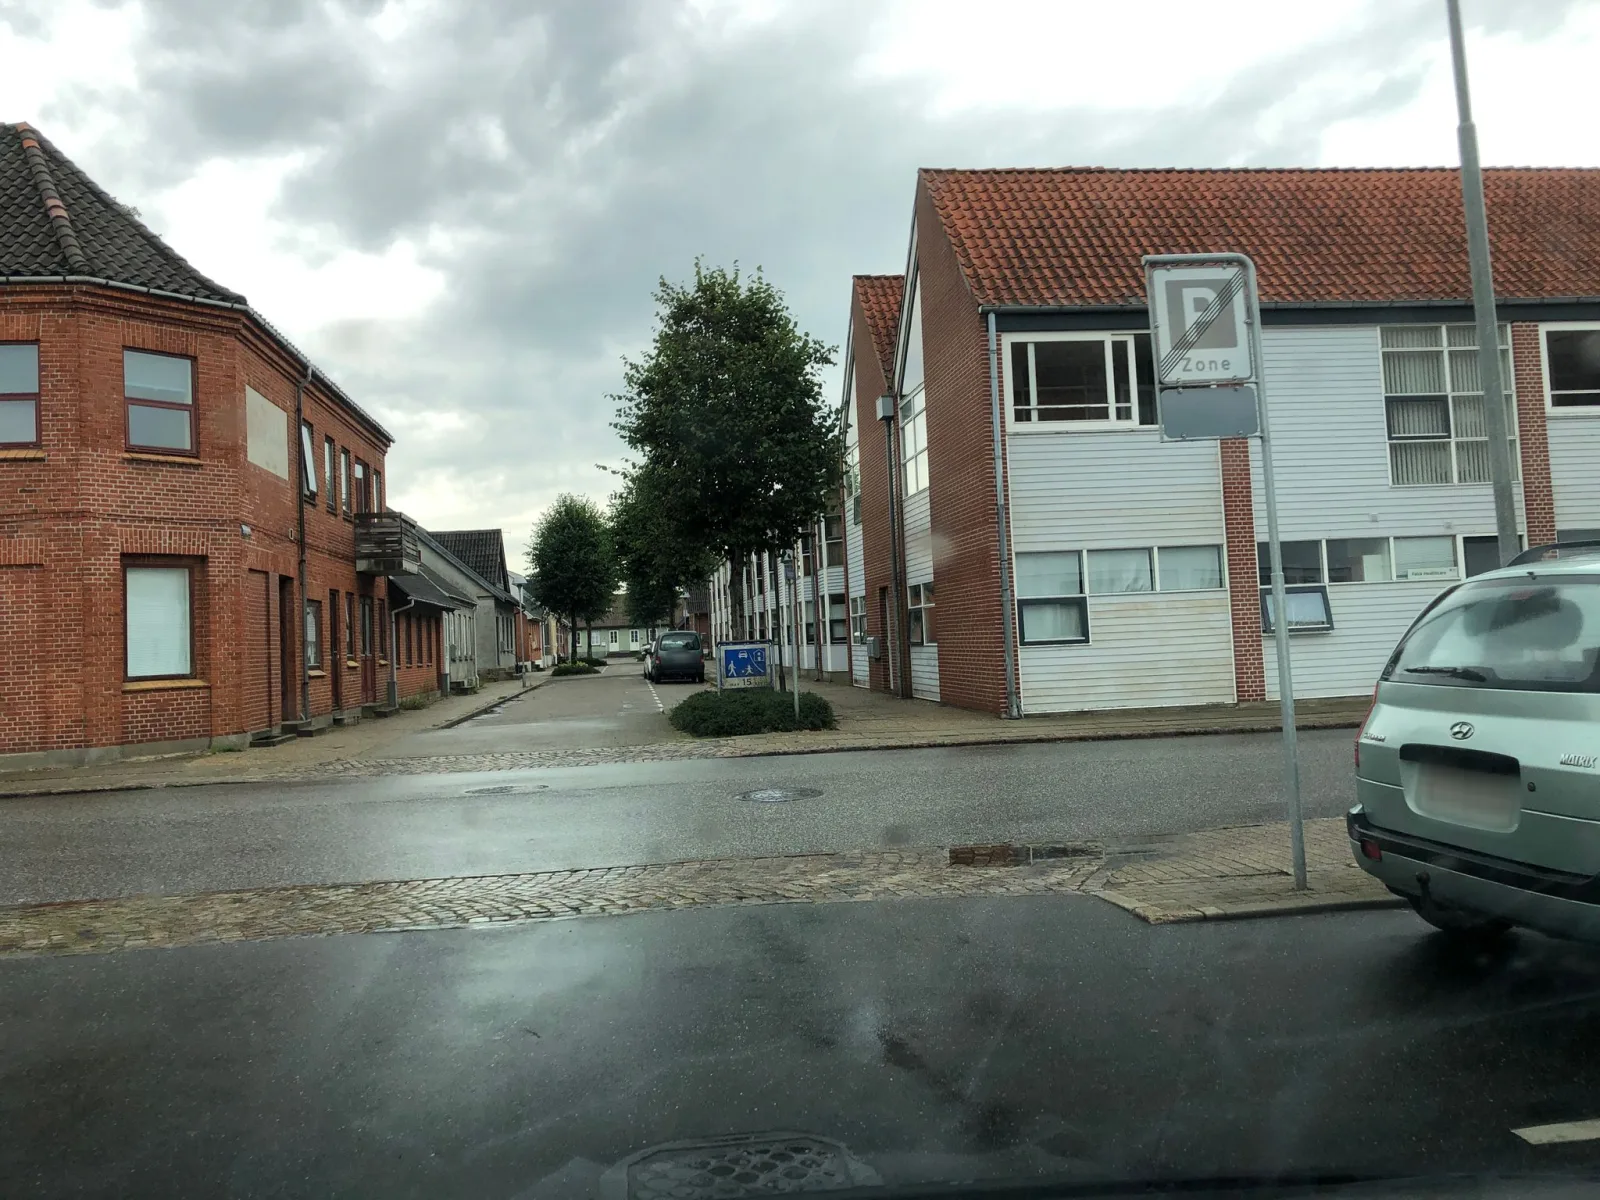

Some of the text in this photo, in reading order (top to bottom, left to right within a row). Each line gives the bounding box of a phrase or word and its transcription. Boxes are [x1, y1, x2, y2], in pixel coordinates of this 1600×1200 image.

[1182, 287, 1221, 343] P
[1182, 357, 1231, 373] Zone
[742, 678, 752, 686] 15
[1559, 753, 1597, 769] MATRIX
